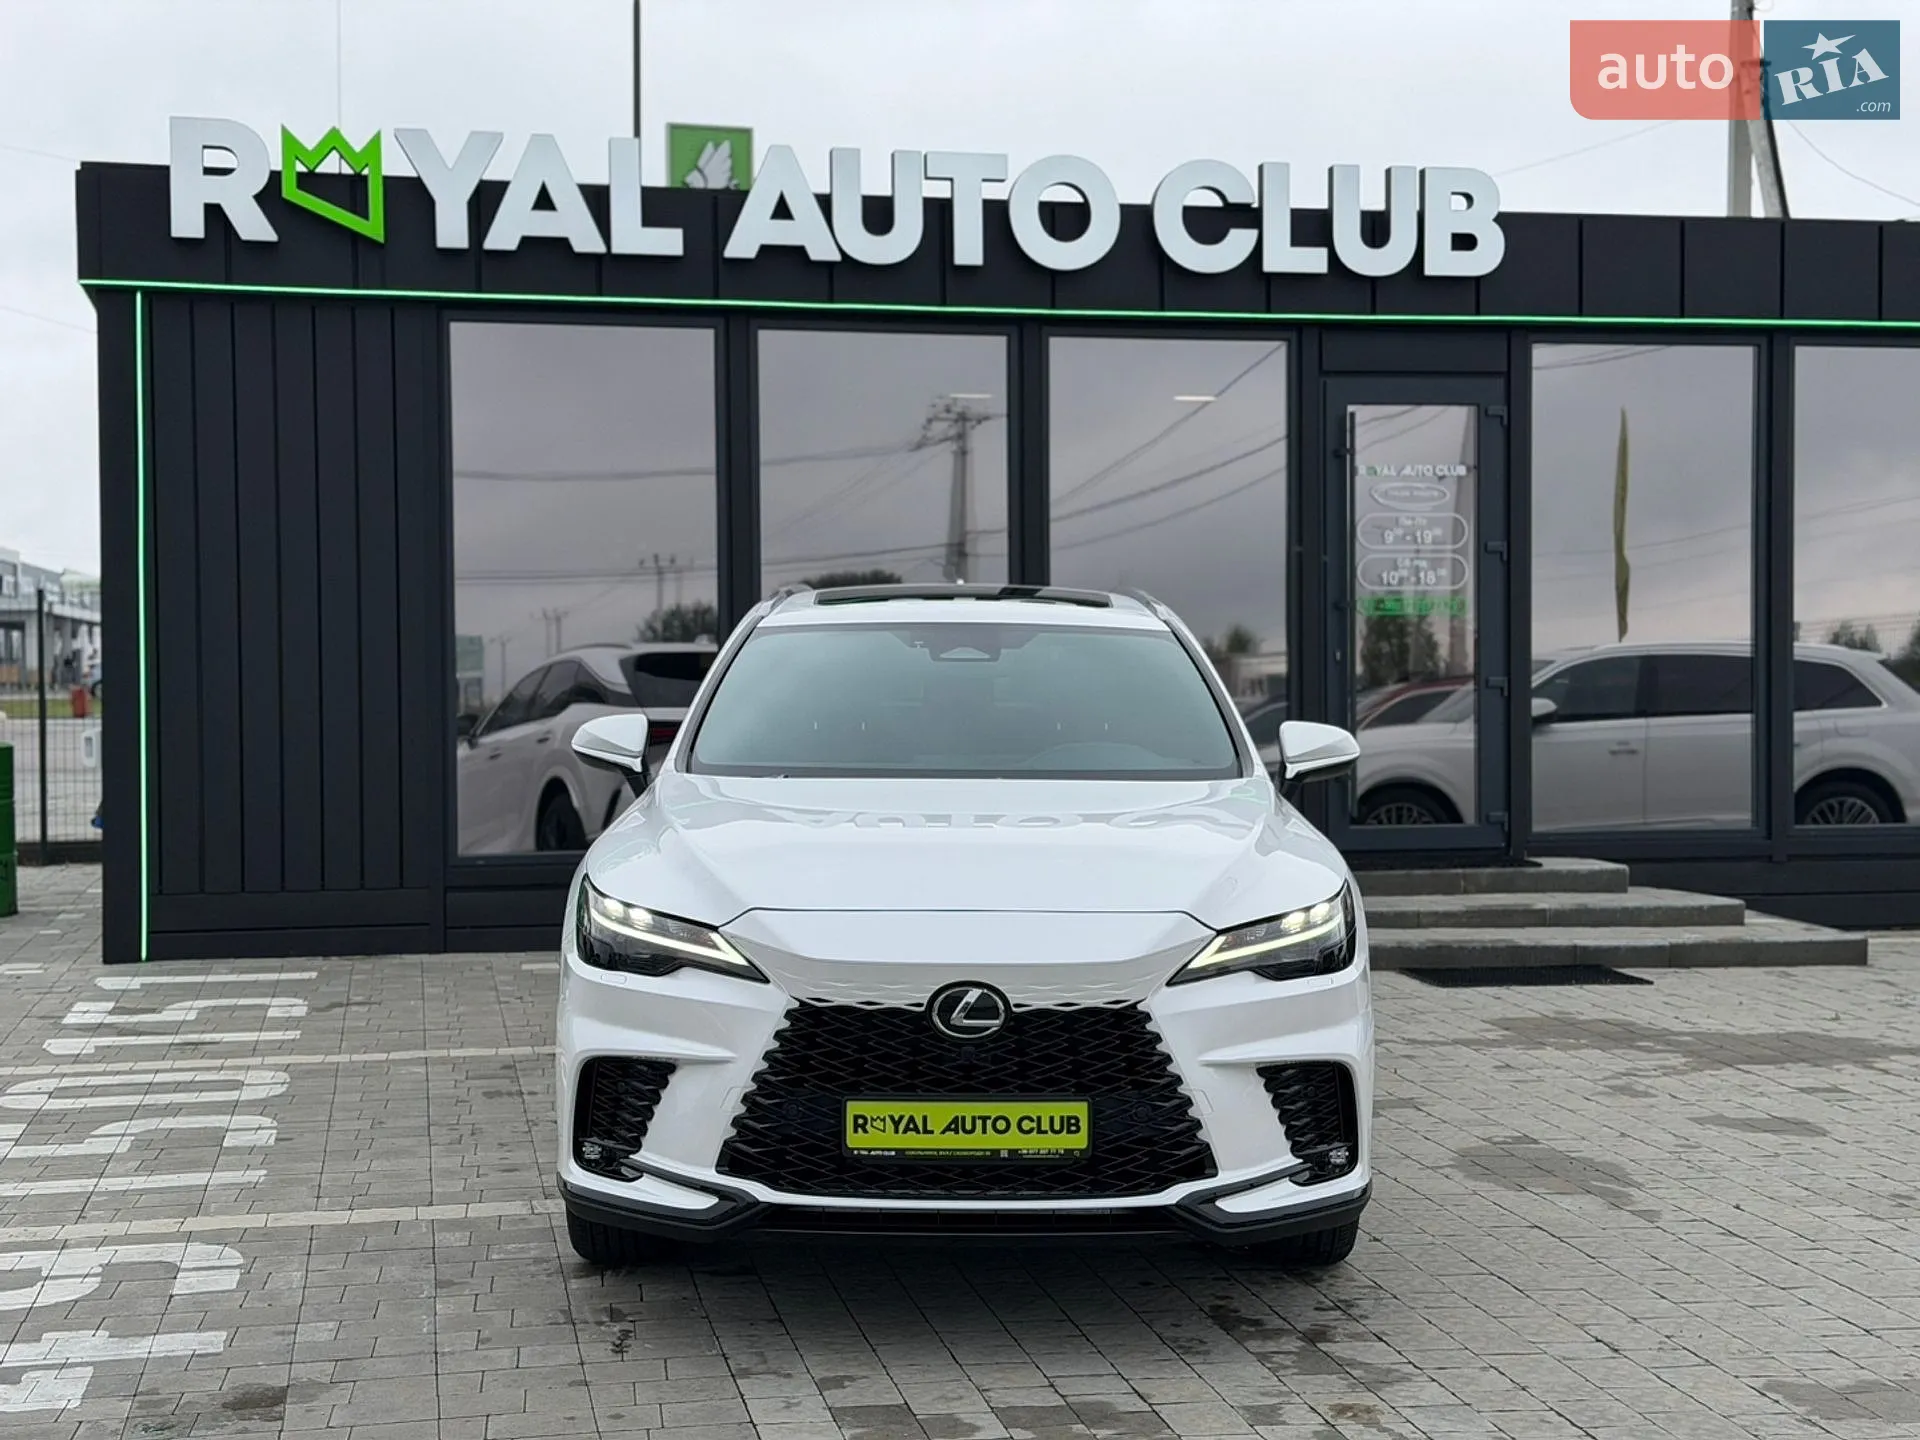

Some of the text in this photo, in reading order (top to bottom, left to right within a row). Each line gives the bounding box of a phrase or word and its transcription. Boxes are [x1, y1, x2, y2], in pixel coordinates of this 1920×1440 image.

[723, 145, 1121, 271] AUTO
[1152, 158, 1506, 279] CLUB
[1399, 464, 1434, 477] AUTO
[940, 1114, 1012, 1135] AUTO
[1016, 1114, 1082, 1135] CLUB
